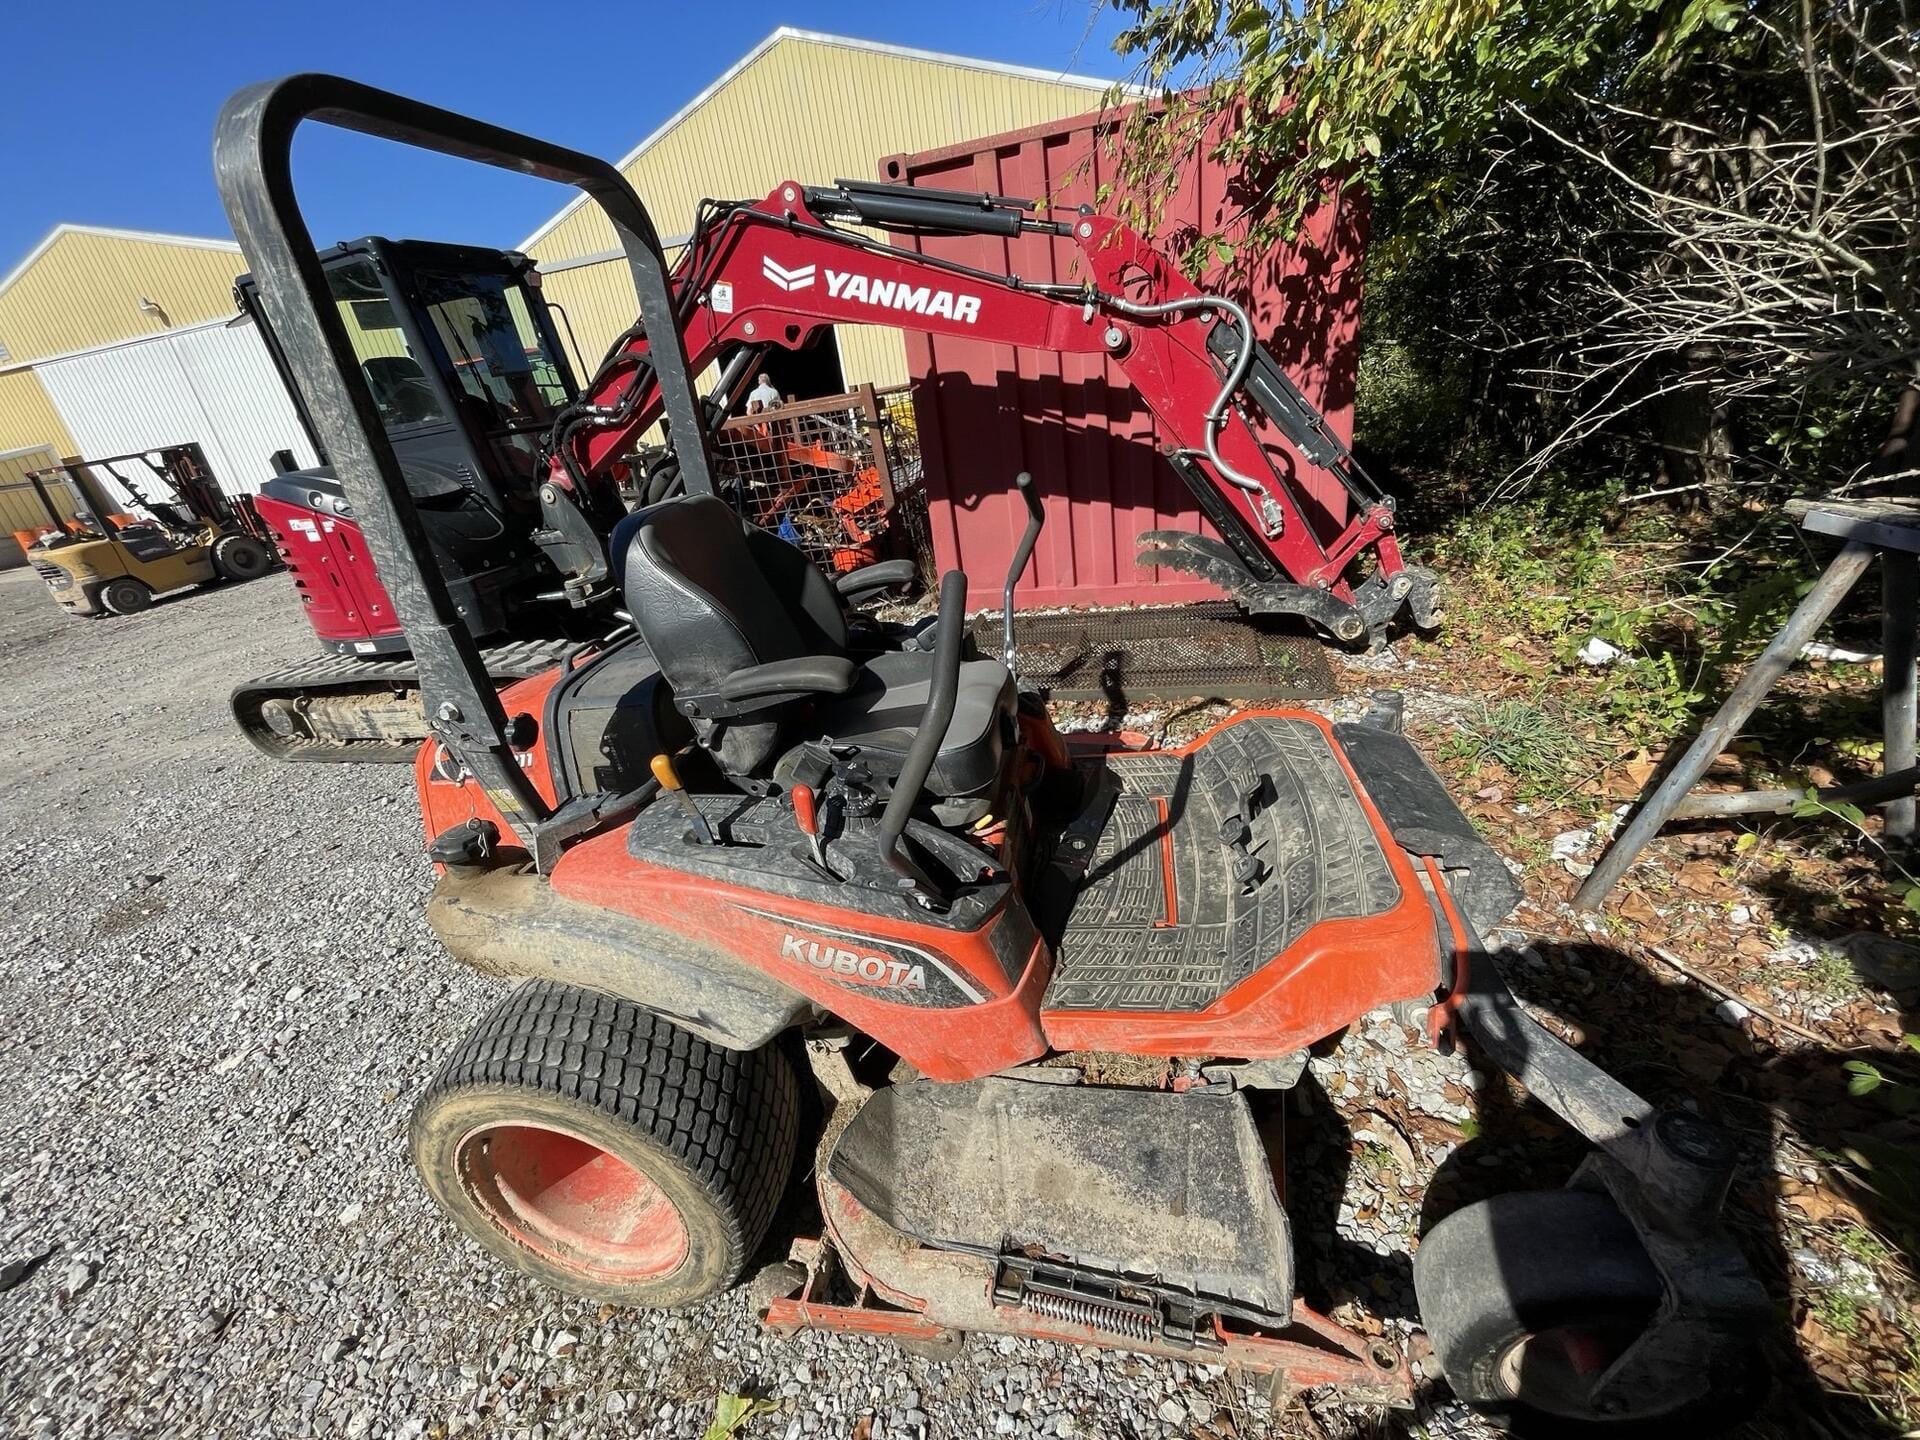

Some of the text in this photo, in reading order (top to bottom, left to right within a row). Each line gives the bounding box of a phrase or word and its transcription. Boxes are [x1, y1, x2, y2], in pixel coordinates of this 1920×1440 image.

[824, 269, 982, 324] YANMAR
[1094, 825, 1115, 888] KUBOA
[780, 934, 927, 990] KUBOTA
